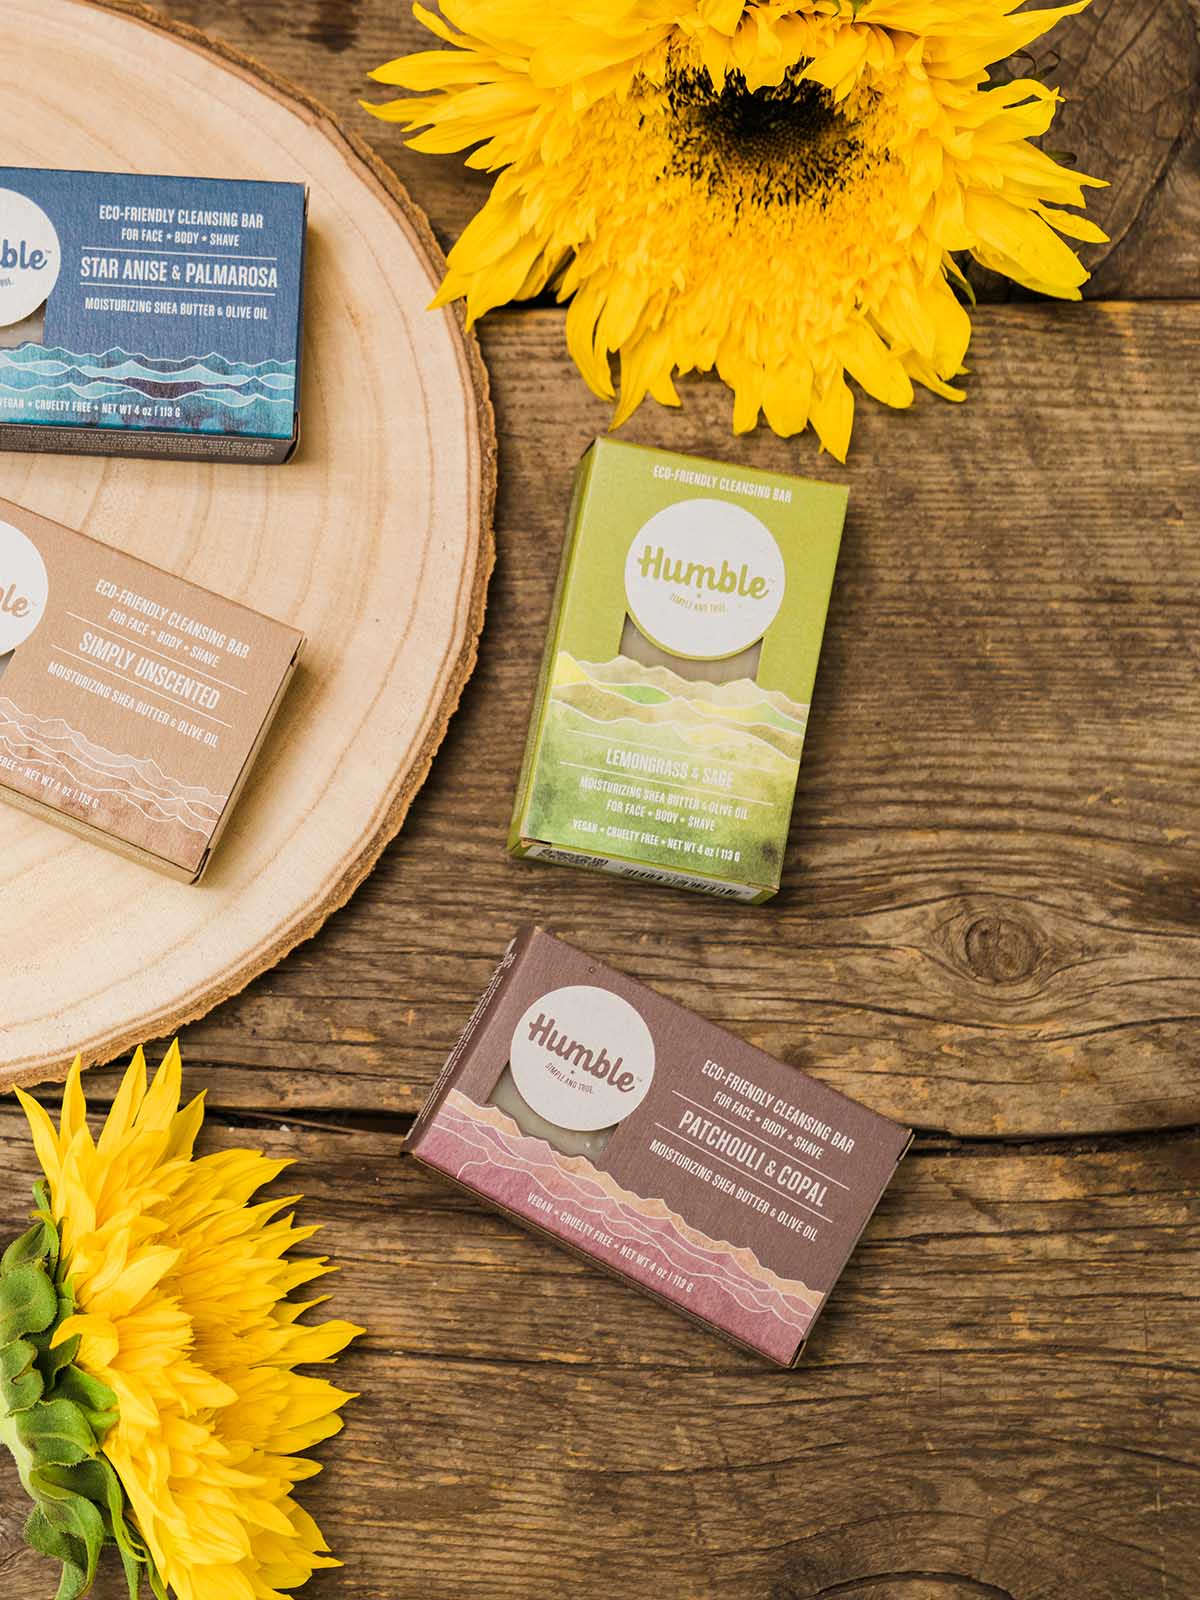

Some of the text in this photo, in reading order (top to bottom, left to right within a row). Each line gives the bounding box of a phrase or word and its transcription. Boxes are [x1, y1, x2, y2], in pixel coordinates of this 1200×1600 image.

[99, 204, 263, 228] ECO-FRIENDLY CLEANSING BAR
[121, 228, 239, 246] FOR FACE BODY SHAVE
[80, 257, 278, 287] STAR ANISE & PALMAROSA
[84, 298, 151, 313] MOISTURIZING
[154, 302, 177, 314] SHEA
[180, 303, 214, 316] BUTTER
[225, 306, 250, 318] OLIVE
[253, 307, 268, 319] OIL
[34, 398, 69, 410] CRUELTY
[72, 401, 90, 411] FREE
[101, 402, 116, 413] NET
[118, 403, 131, 414] WT
[134, 404, 139, 414] 4
[142, 405, 151, 414] oz
[160, 406, 171, 416] 113
[174, 406, 180, 416] G
[653, 464, 792, 503] ECO-FRIENDLY CLEANSING BAR
[638, 545, 768, 599] Humble
[95, 579, 249, 657] ECO-FRIENDLY CLEANSING BAR
[107, 609, 219, 666] FOR FACE BODY SHAVE
[78, 632, 220, 709] SIMPLY UNSCENTED
[47, 662, 111, 698] MOISTURIZING
[111, 691, 135, 709] SHEA
[135, 701, 169, 724] BUTTER
[177, 720, 203, 739] OLIVE
[203, 732, 219, 746] OIL
[605, 748, 735, 789] LEMONGRASS & SAGE
[579, 776, 641, 798] MOISTURIZING
[642, 788, 665, 803] SHEA
[666, 793, 700, 810] BUTTER
[708, 801, 733, 816] OLIVE
[735, 806, 749, 819] OIL
[606, 800, 715, 831] FOR FACE BODY SHAVE
[571, 819, 598, 833] VEGAN
[606, 826, 639, 841] CRUELTY
[640, 833, 659, 845] FREE
[666, 838, 682, 850] NET
[683, 841, 695, 852] WT
[529, 1014, 635, 1092] Humble
[701, 1060, 855, 1153] ECO-FRIENDLY CLEANSING BAR
[713, 1092, 824, 1159] FOR FACE BODY SHAVE
[678, 1110, 830, 1206] PATCHOULI & COPAL
[649, 1141, 712, 1182] MOISTURIZING
[711, 1175, 735, 1195] SHEA
[735, 1188, 769, 1213] BUTTER
[776, 1211, 803, 1232] OLIVE
[802, 1225, 819, 1241] OIL
[527, 1193, 552, 1212] VEGAN
[560, 1211, 593, 1235] CRUELTY
[593, 1230, 613, 1246] FREE
[620, 1244, 636, 1259] NET
[635, 1253, 649, 1267] WT
